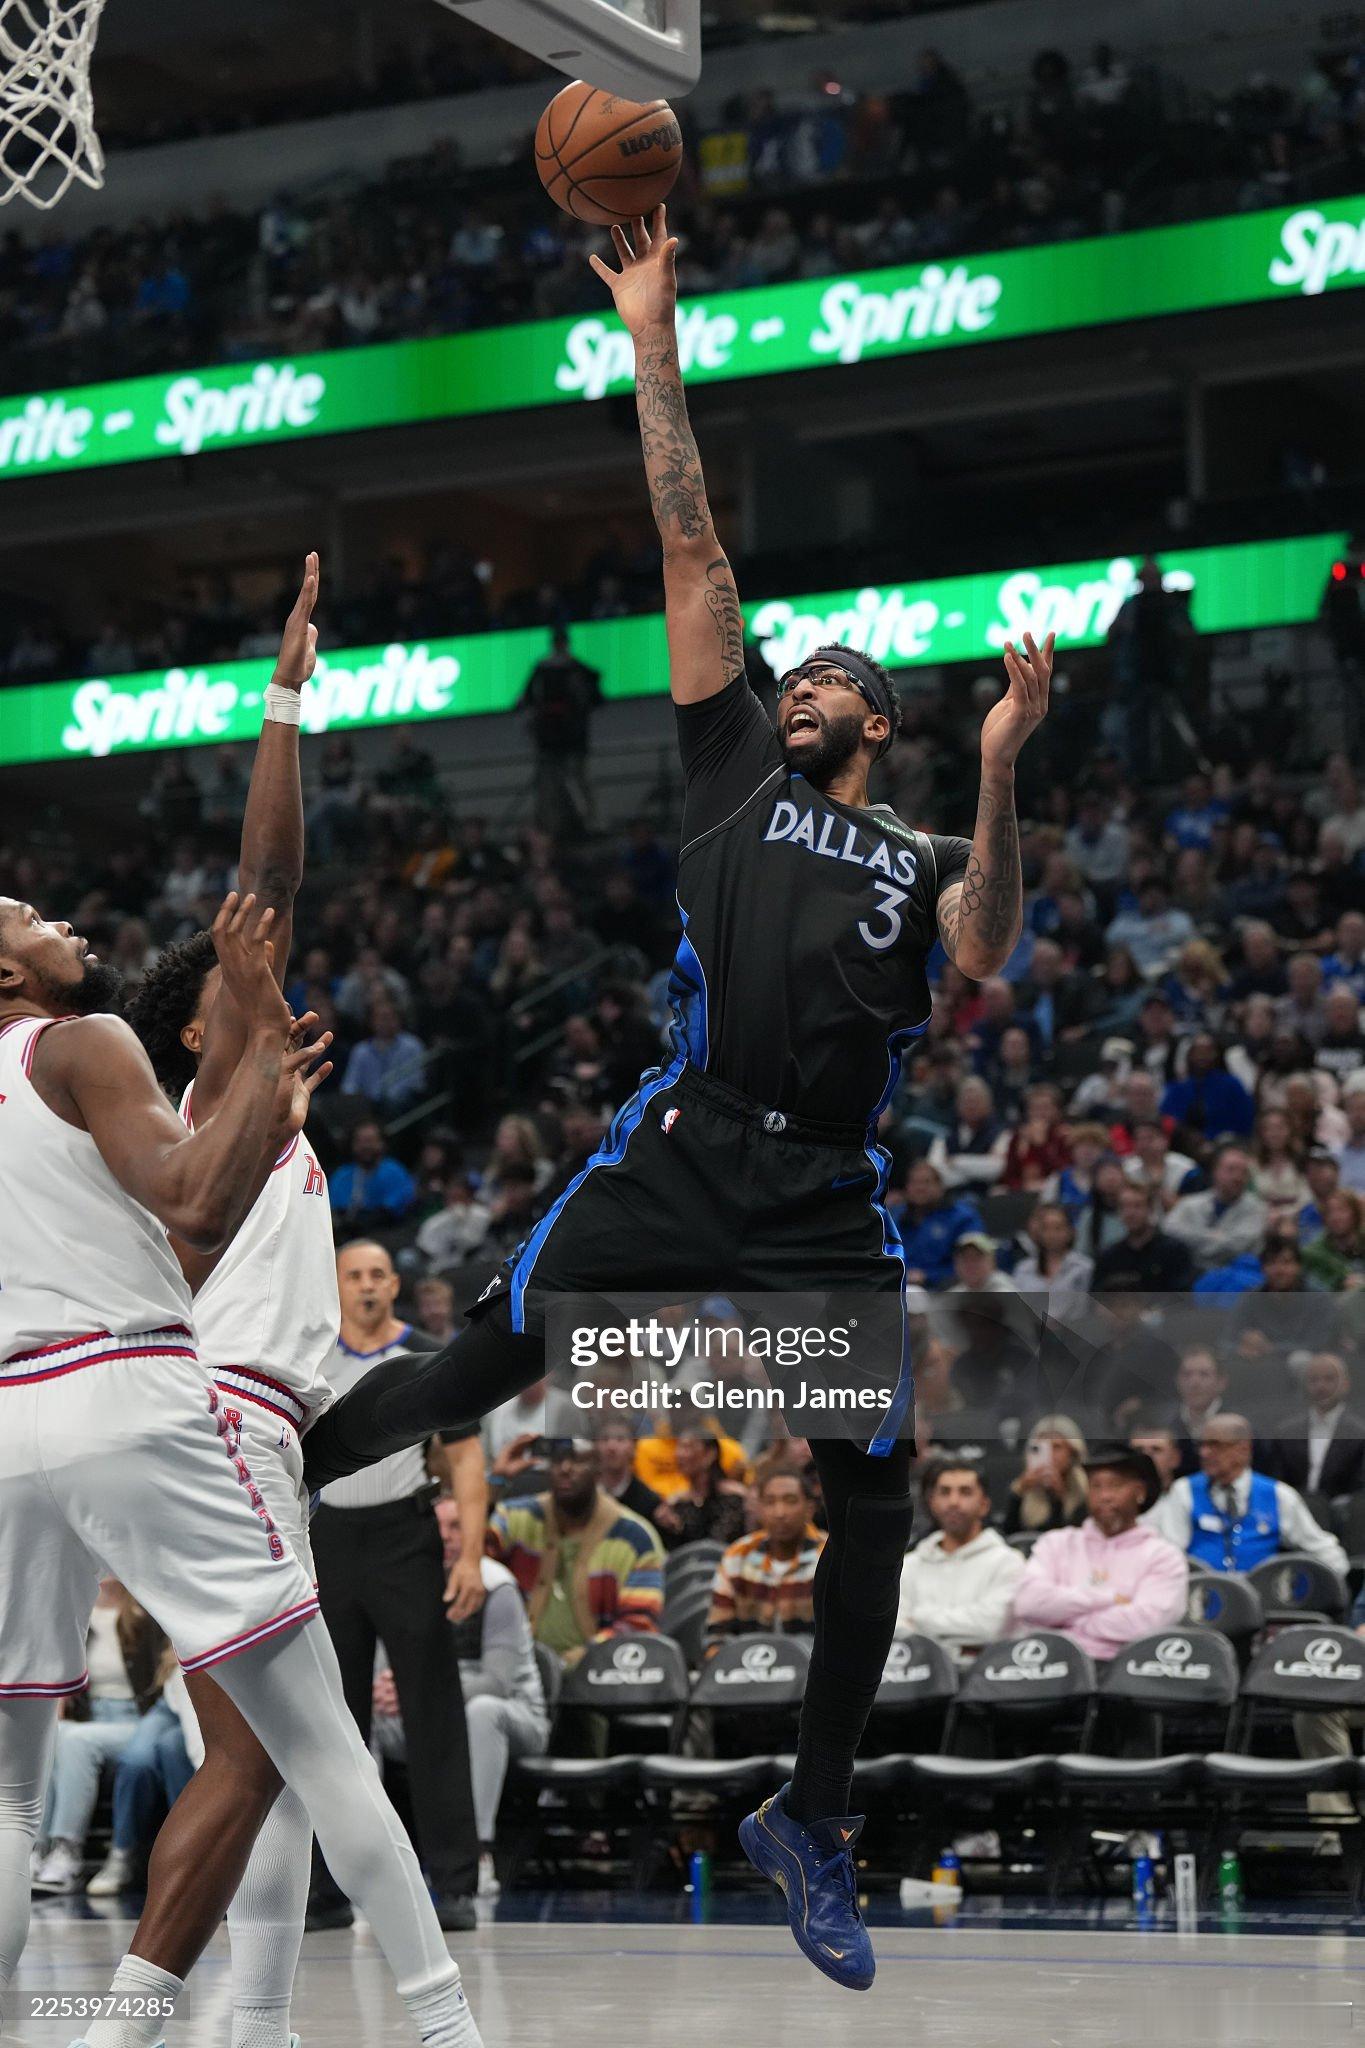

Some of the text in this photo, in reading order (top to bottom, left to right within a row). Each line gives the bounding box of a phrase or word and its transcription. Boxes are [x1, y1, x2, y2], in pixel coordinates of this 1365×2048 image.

[809, 265, 1001, 364] Sprite
[555, 304, 738, 400] Spte
[155, 363, 326, 455] Sprite
[62, 668, 238, 757] Sprite
[763, 799, 917, 886] DALLAS
[858, 880, 909, 950] 3
[587, 1666, 664, 1685] LEXUS
[715, 1665, 796, 1684] LEXUS
[880, 1664, 931, 1684] XUS
[984, 1661, 1068, 1681] LEXUS
[1127, 1659, 1211, 1679] LEXUS
[1274, 1659, 1362, 1680] LEXUS
